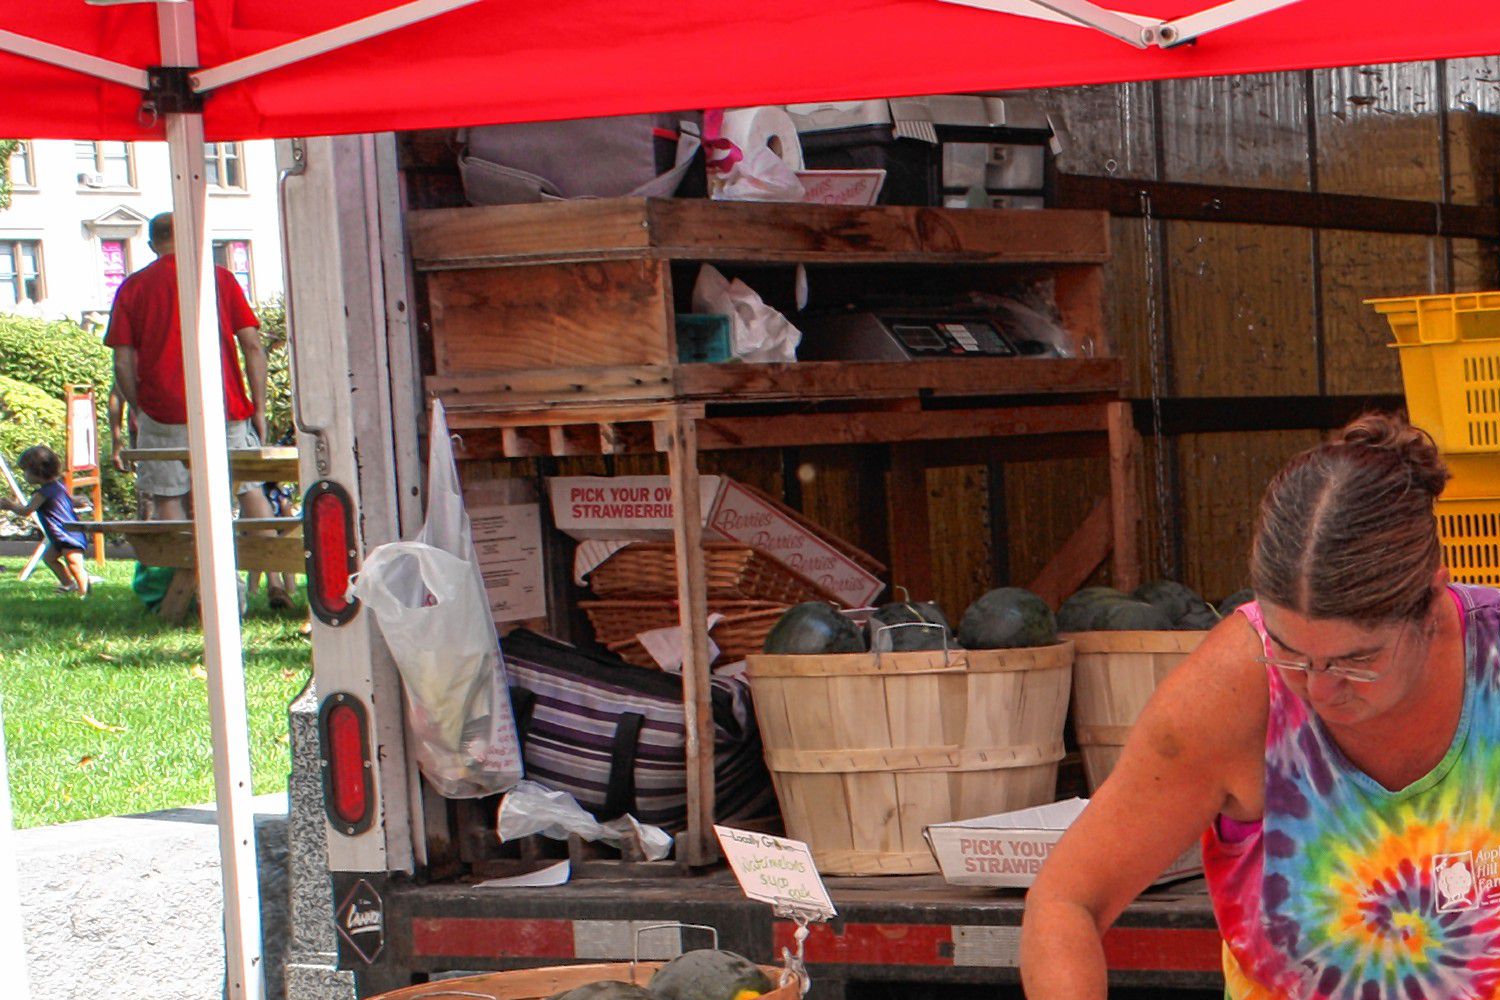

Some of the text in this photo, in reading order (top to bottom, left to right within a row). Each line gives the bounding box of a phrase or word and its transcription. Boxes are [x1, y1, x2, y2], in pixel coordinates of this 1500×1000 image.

[570, 487, 673, 502] PICK YOUR OW
[571, 503, 674, 518] STRAWBERRIE
[718, 508, 774, 529] Berries
[750, 530, 806, 550] Berries
[788, 552, 838, 572] Berries
[817, 573, 866, 592] Berries
[960, 838, 1003, 856] PICK
[964, 857, 1044, 874] STRAWB
[1476, 861, 1498, 878] Hill
